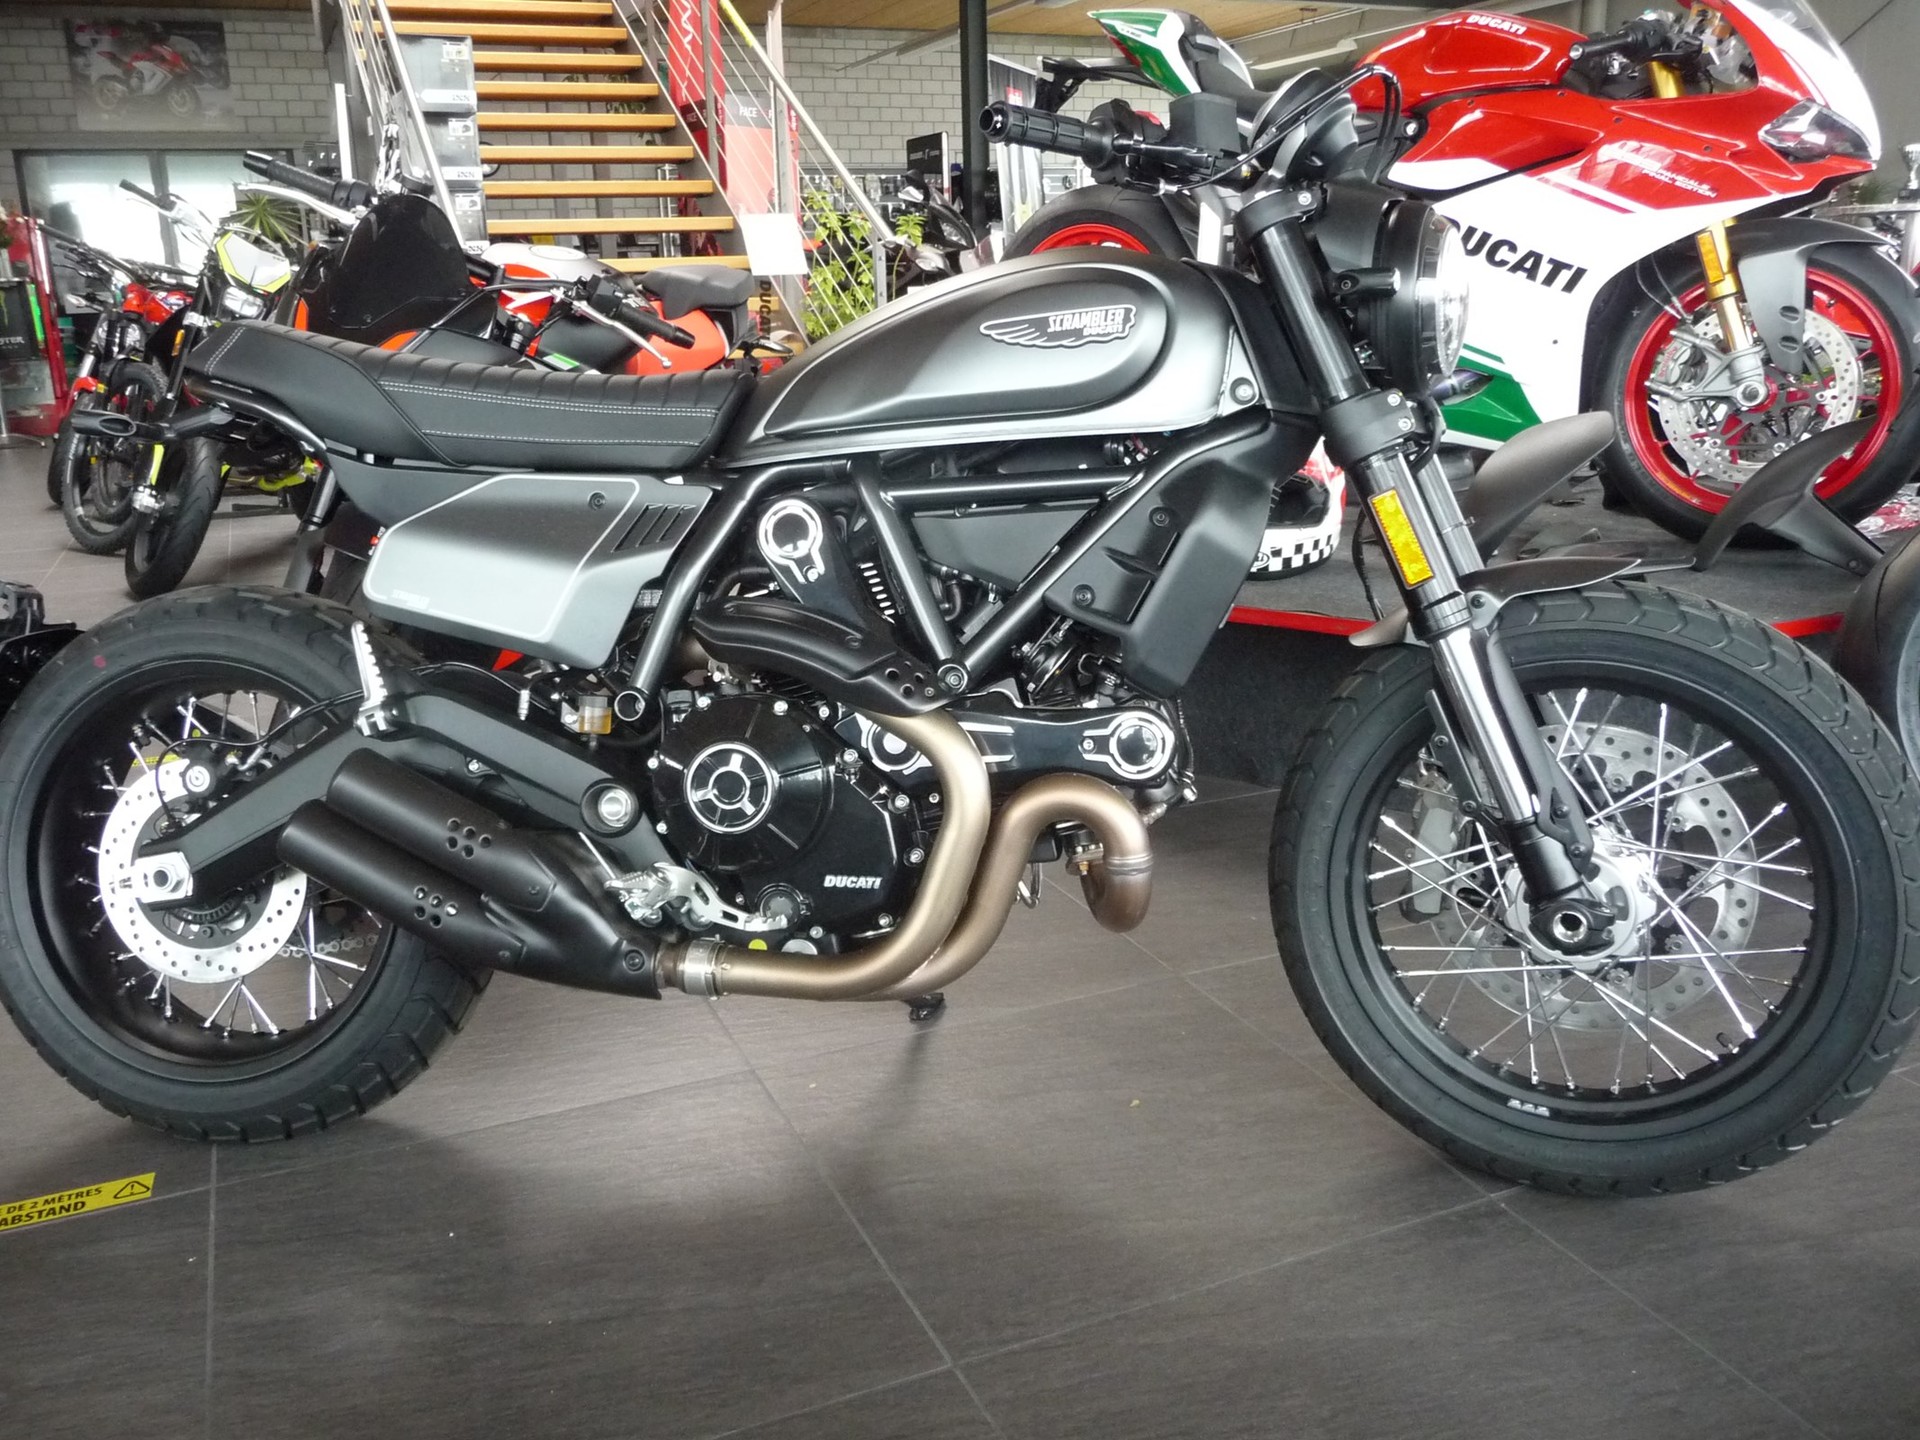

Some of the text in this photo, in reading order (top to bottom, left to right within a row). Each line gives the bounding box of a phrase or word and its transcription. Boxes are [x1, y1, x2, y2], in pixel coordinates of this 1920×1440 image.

[1465, 14, 1528, 35] DUCATI
[1673, 179, 1718, 198] EDITION
[1047, 308, 1125, 333] SCRAMBLER
[1083, 324, 1123, 337] DUCATI
[823, 874, 883, 889] DUCATI
[0, 1201, 86, 1227] ABSTAND
[6, 1203, 26, 1214] DE
[29, 1201, 38, 1209] 2
